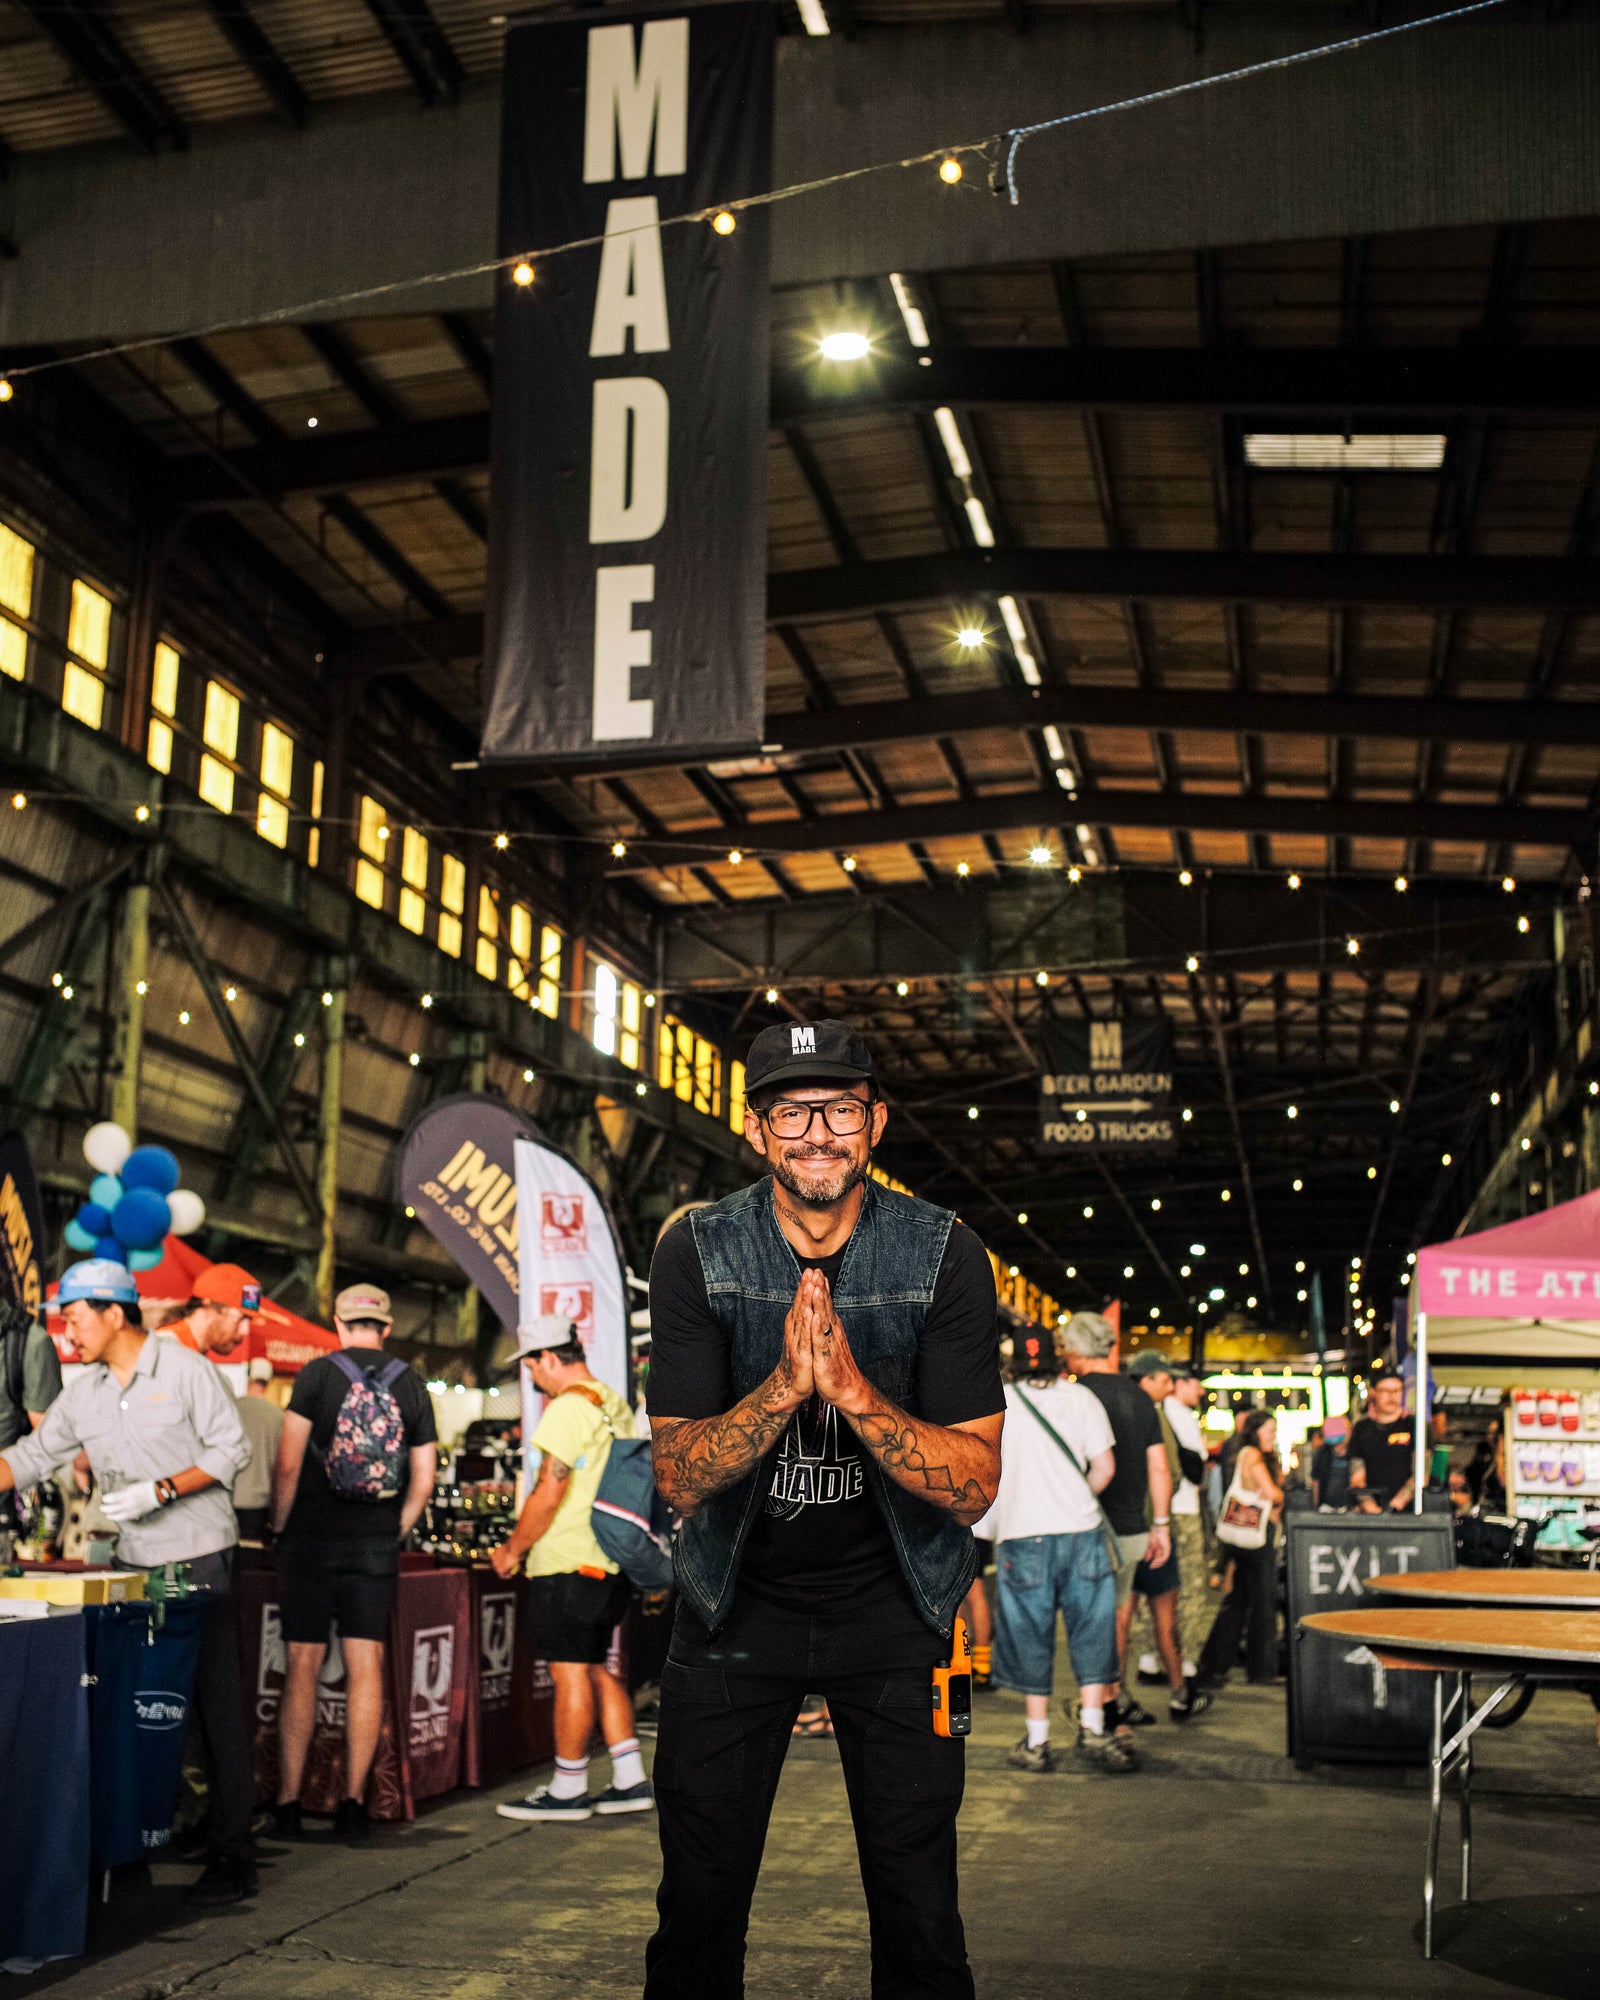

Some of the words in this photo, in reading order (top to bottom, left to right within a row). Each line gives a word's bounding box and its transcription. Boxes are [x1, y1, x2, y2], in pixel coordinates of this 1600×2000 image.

[583, 18, 689, 741] MADE
[791, 1026, 816, 1048] M
[792, 1045, 817, 1056] MADE
[1090, 1022, 1122, 1058] M
[1042, 1074, 1090, 1095] BEER
[1094, 1073, 1172, 1094] GARDEN
[1043, 1121, 1095, 1142] FOOD
[1099, 1121, 1173, 1141] TRUCKS
[1440, 1266, 1517, 1297] THE
[1308, 1545, 1420, 1596] EXIT
[961, 1629, 971, 1657] BCA
